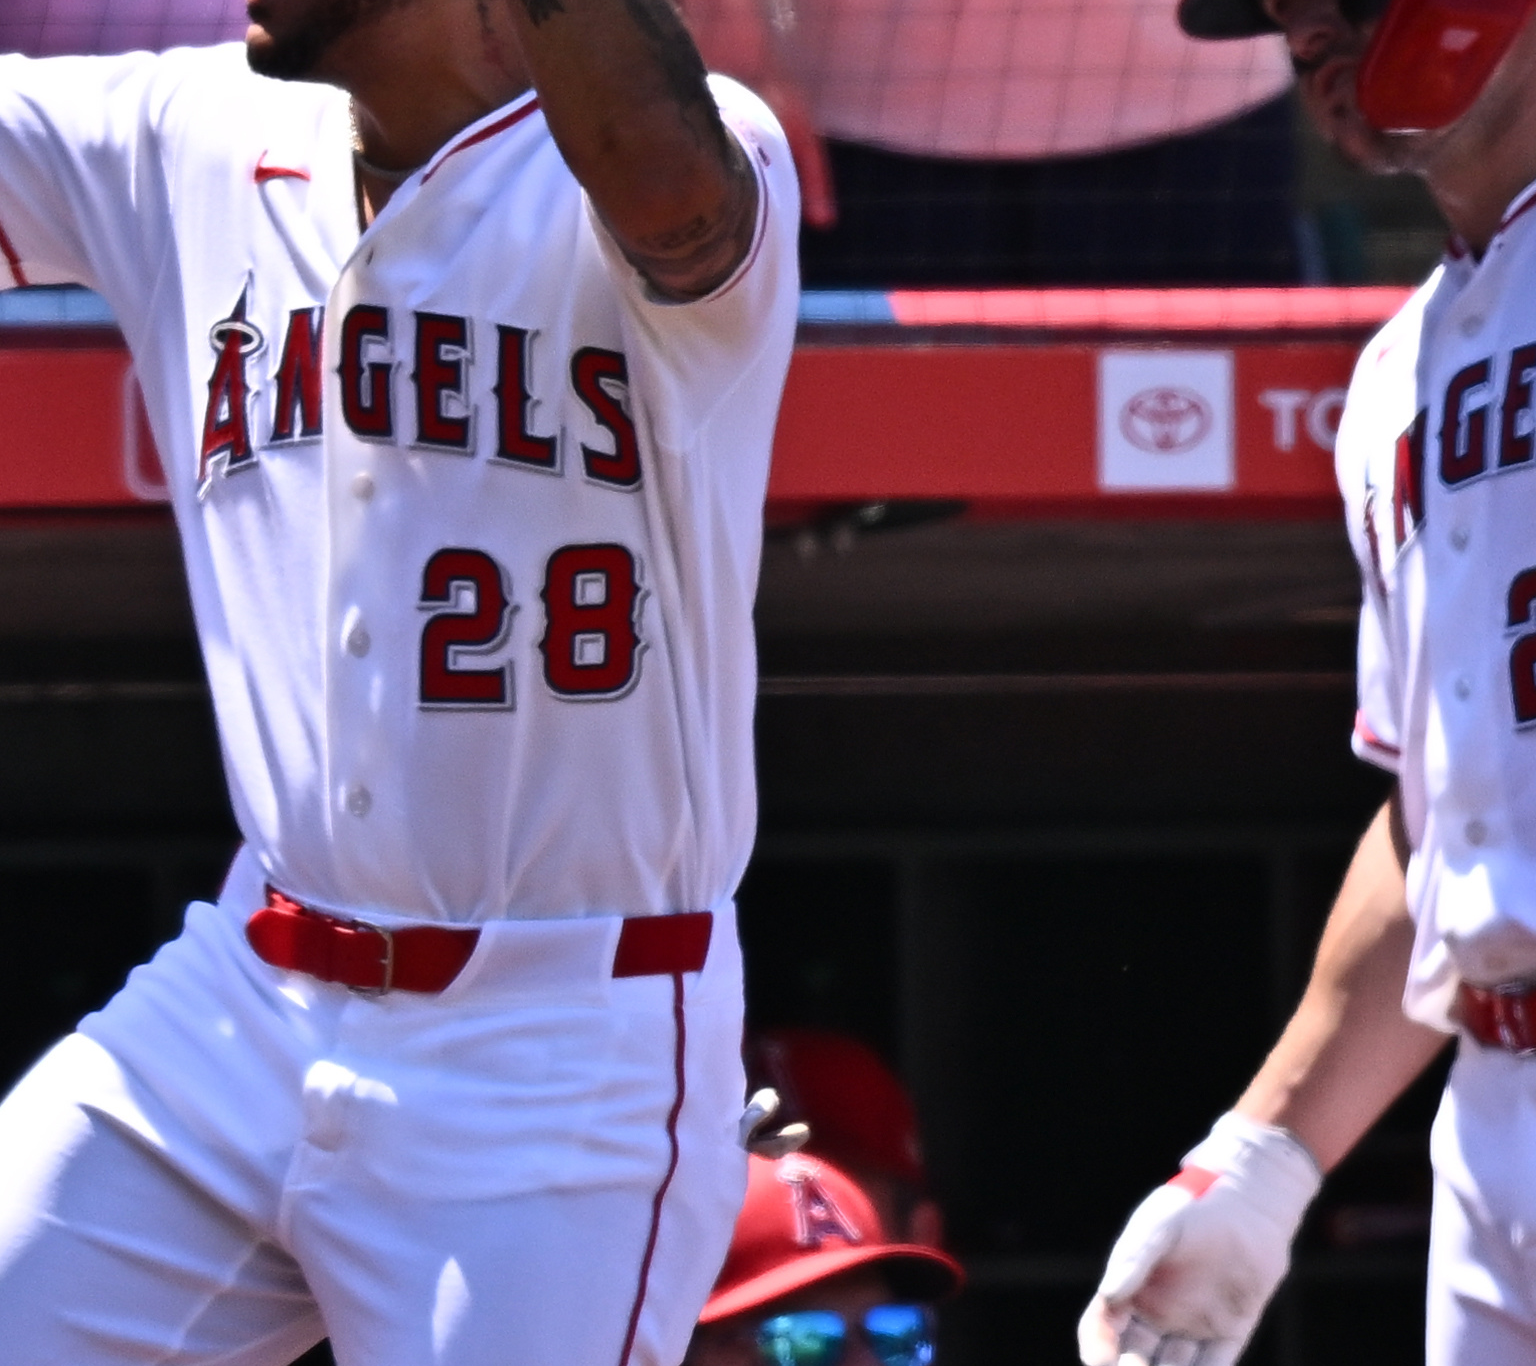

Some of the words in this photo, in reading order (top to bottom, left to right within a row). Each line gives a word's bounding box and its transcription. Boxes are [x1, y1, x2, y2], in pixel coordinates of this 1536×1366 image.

[197, 271, 645, 500] ANGELS
[417, 543, 650, 712] 28
[776, 1151, 862, 1247] A
